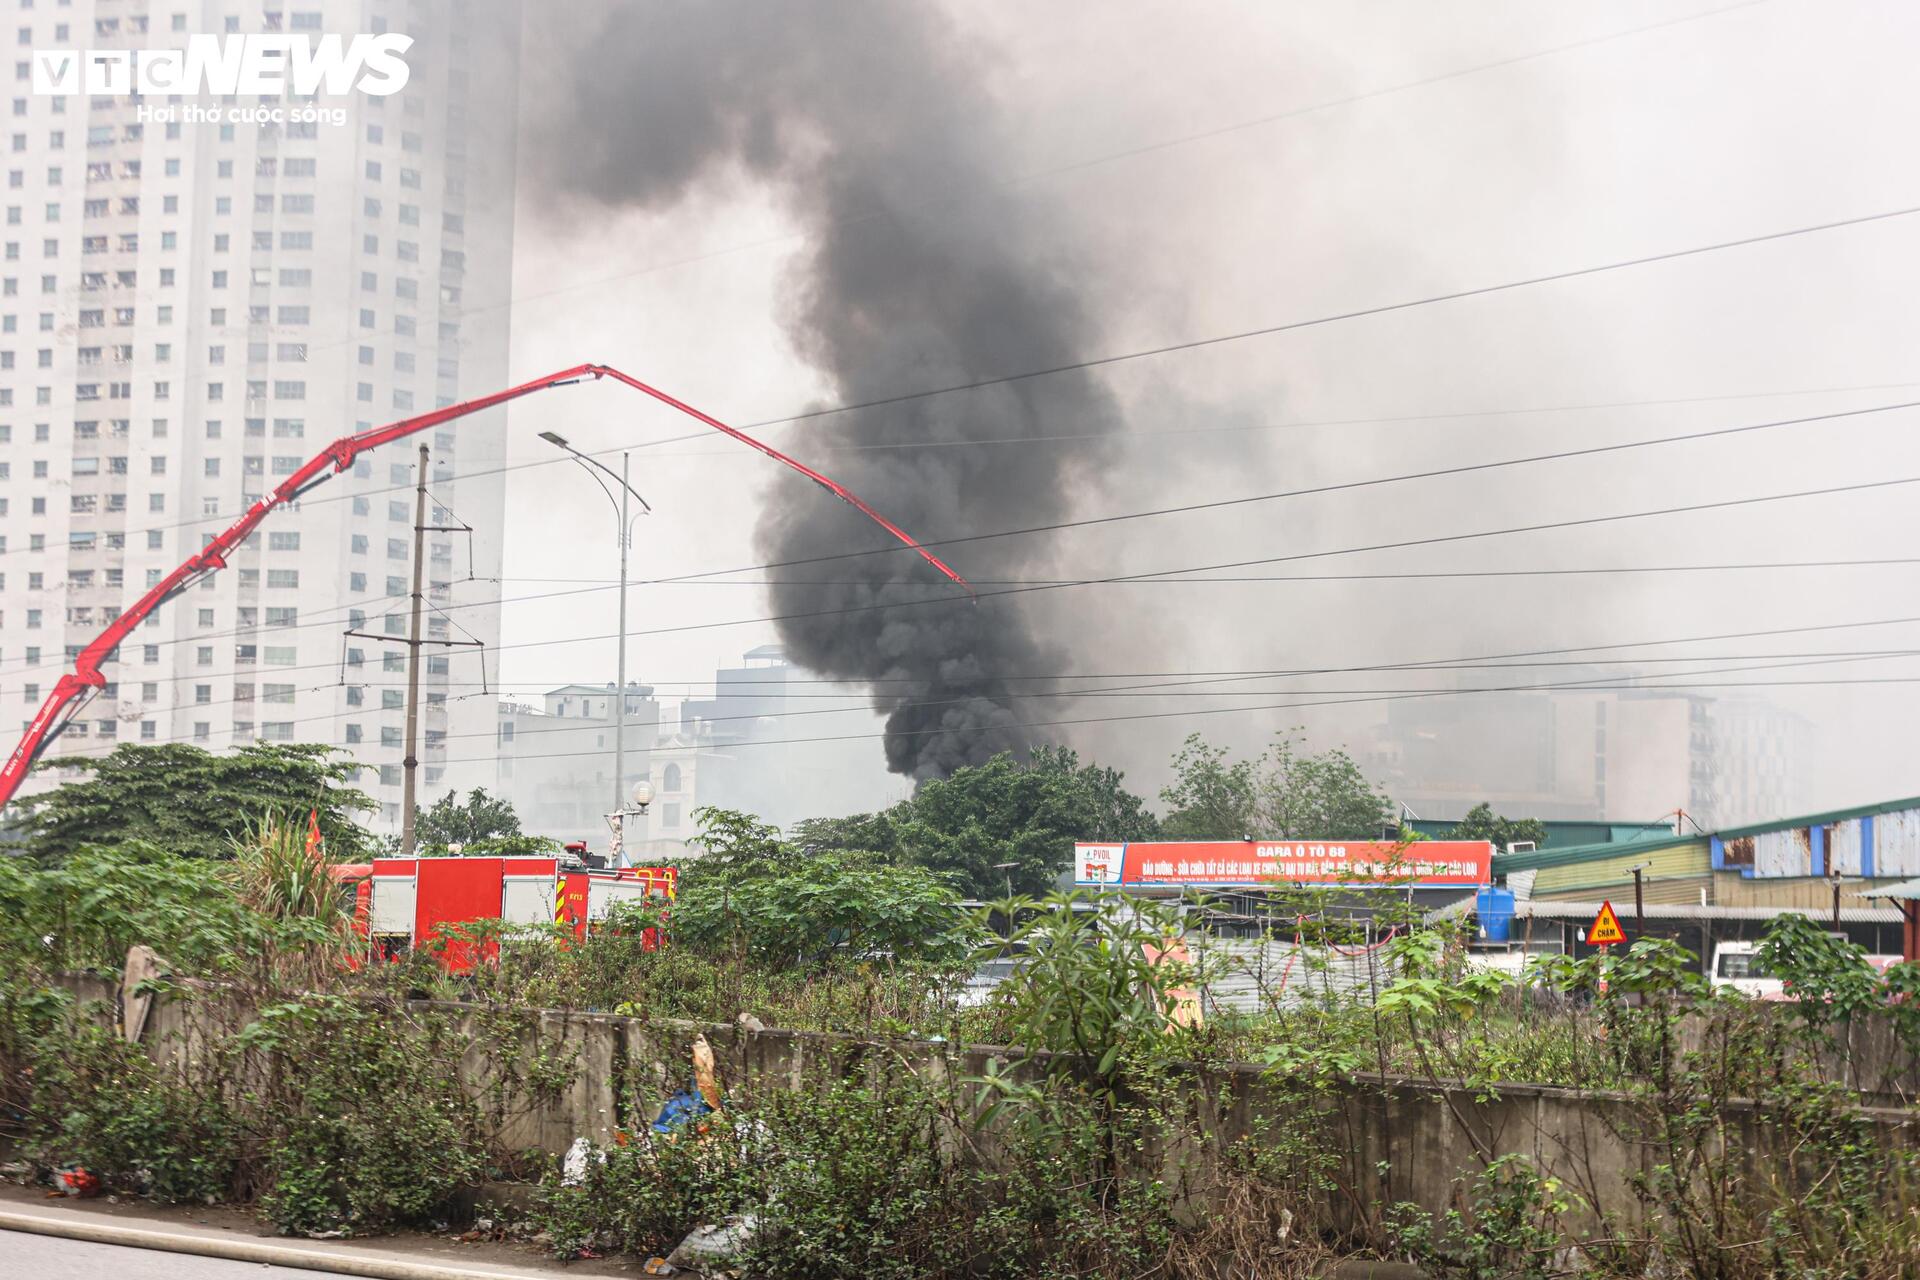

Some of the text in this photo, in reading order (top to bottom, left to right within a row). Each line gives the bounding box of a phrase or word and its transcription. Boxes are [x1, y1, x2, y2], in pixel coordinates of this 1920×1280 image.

[1256, 846, 1292, 858] GARA
[1295, 844, 1305, 858] Ô
[1308, 844, 1325, 858] TÔ
